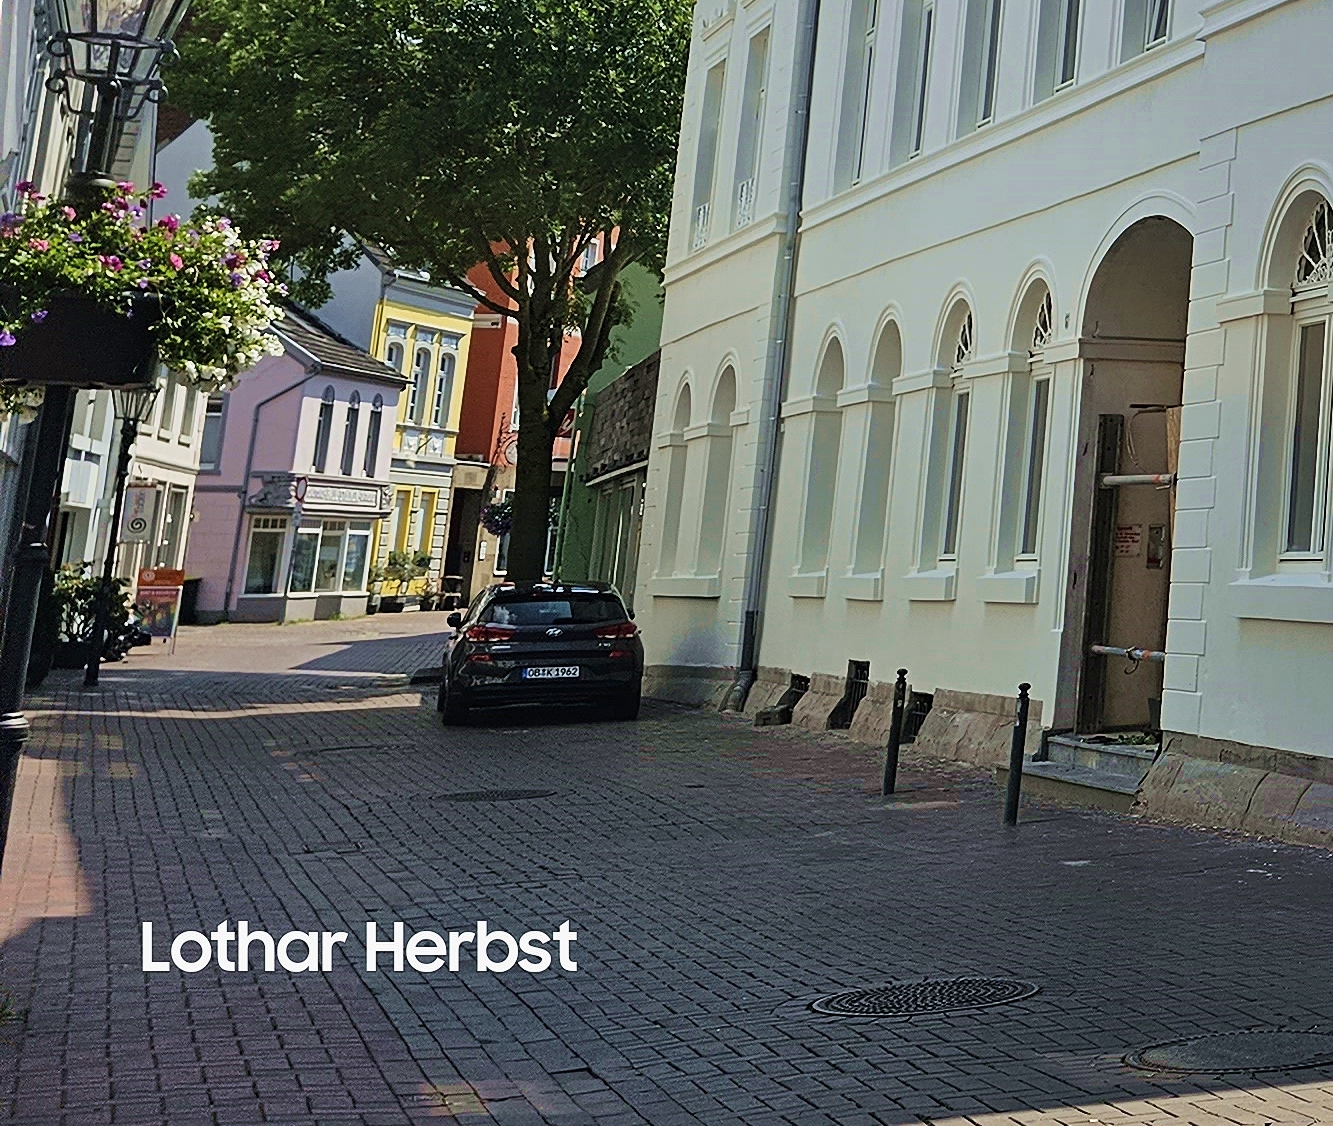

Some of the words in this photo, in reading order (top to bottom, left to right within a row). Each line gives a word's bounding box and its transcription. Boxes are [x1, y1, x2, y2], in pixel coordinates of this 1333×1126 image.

[528, 668, 541, 677] OB
[546, 668, 553, 676] K
[554, 667, 578, 676] 1962
